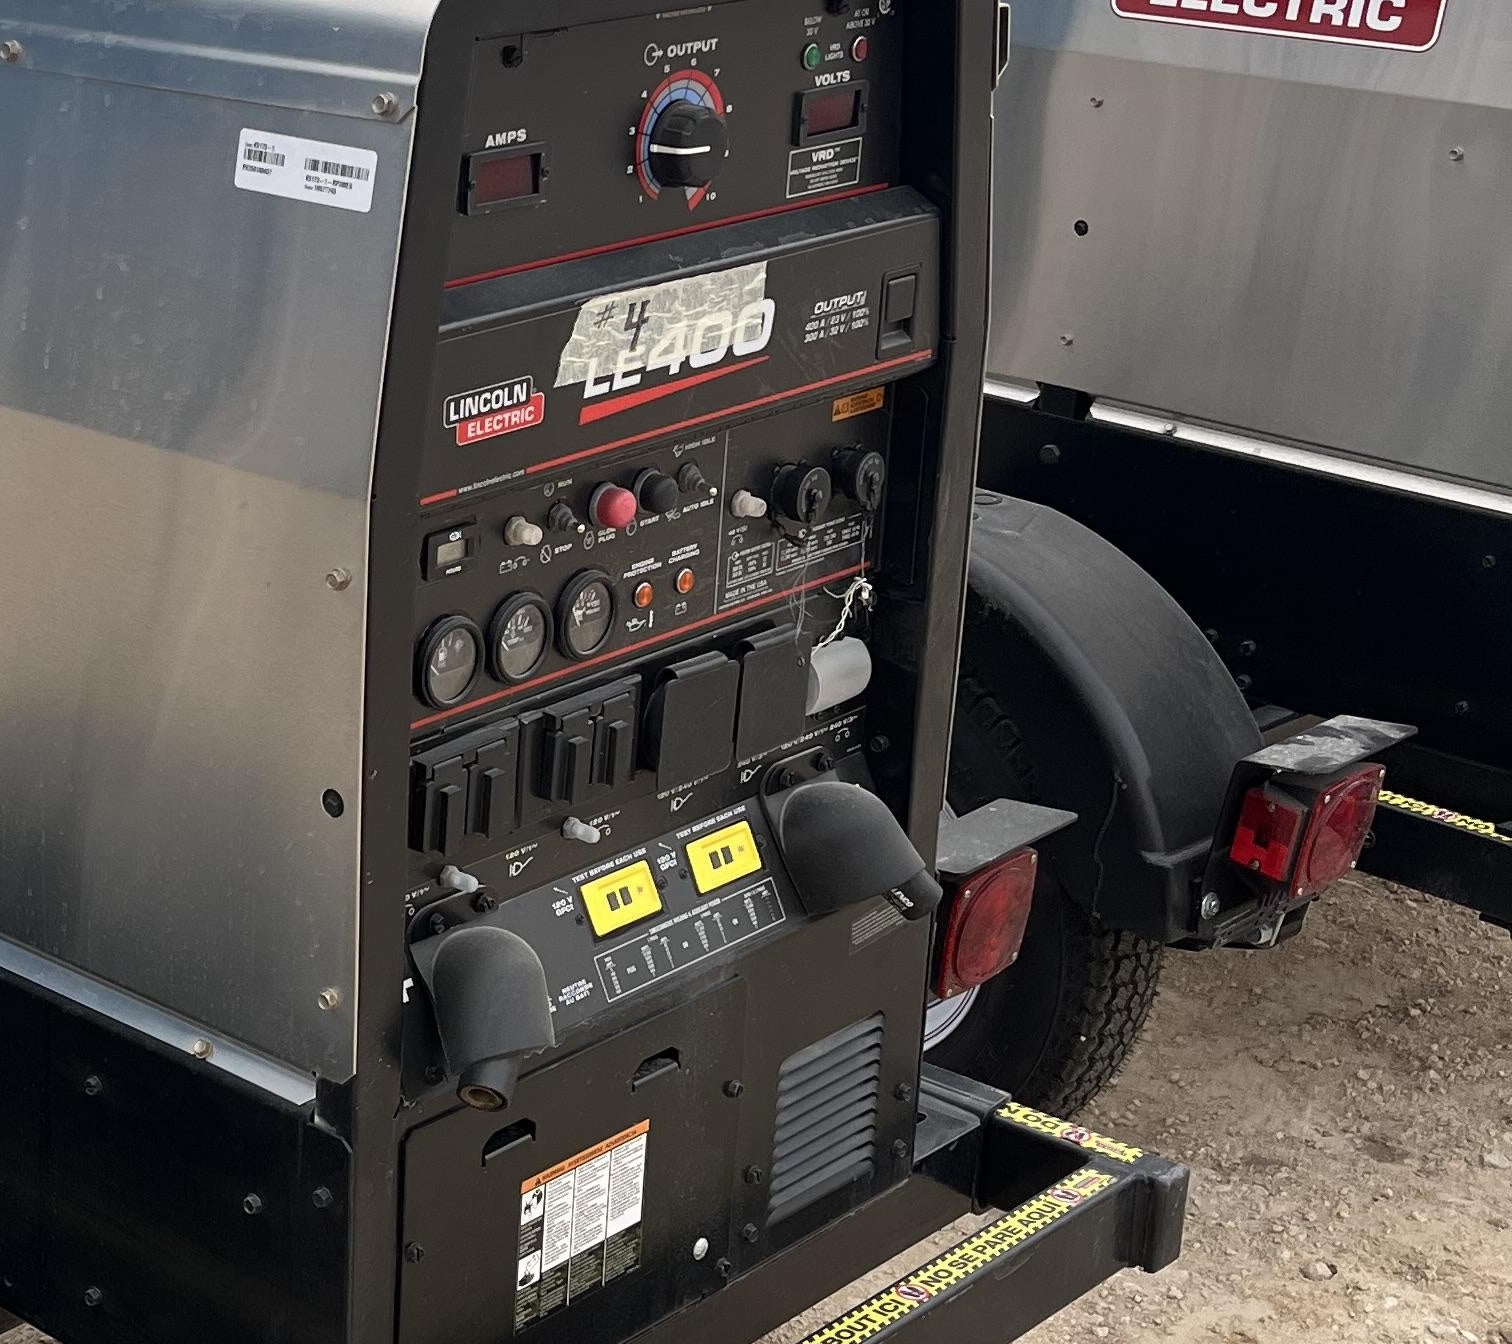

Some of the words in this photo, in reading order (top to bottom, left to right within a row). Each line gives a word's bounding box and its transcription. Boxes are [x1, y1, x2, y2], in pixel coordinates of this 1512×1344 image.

[667, 38, 719, 58] OUTPUT
[664, 65, 671, 74] 5
[714, 68, 721, 77] 7
[814, 70, 851, 87] VOLTS
[641, 90, 648, 99] 4
[485, 128, 527, 149] AMPS
[629, 127, 636, 136] 3
[627, 165, 634, 174] 2
[706, 192, 717, 202] 10
[814, 291, 864, 314] OUTPUT
[449, 382, 528, 422] LINCOLN
[467, 406, 535, 437] ELECTRIC
[682, 502, 699, 513] AUTO
[699, 498, 714, 508] IDLE
[639, 514, 660, 527] START
[598, 533, 616, 544] PLUG
[554, 543, 573, 555] STOP
[671, 543, 698, 557] BATTERY
[631, 557, 655, 571] ENGINE
[668, 549, 700, 565] CHARGING
[623, 562, 663, 579] PROTECTION
[675, 828, 692, 840] TEST
[691, 817, 717, 833] BEFORE
[716, 810, 734, 822] EACH
[733, 805, 747, 818] USE
[505, 849, 520, 860] 120
[656, 854, 670, 865] 120
[669, 850, 677, 860] V
[571, 872, 589, 884] TEST
[589, 861, 615, 878] BEFORE
[614, 853, 634, 867] EACH
[633, 847, 647, 859] USE
[659, 859, 678, 872] GFCI
[552, 898, 568, 910] 120
[566, 895, 574, 905] V
[555, 904, 575, 917] GFCI
[875, 1297, 908, 1318] ICI
[920, 1268, 954, 1289] NO
[950, 1252, 976, 1271] SE
[972, 1225, 1022, 1255] PARE
